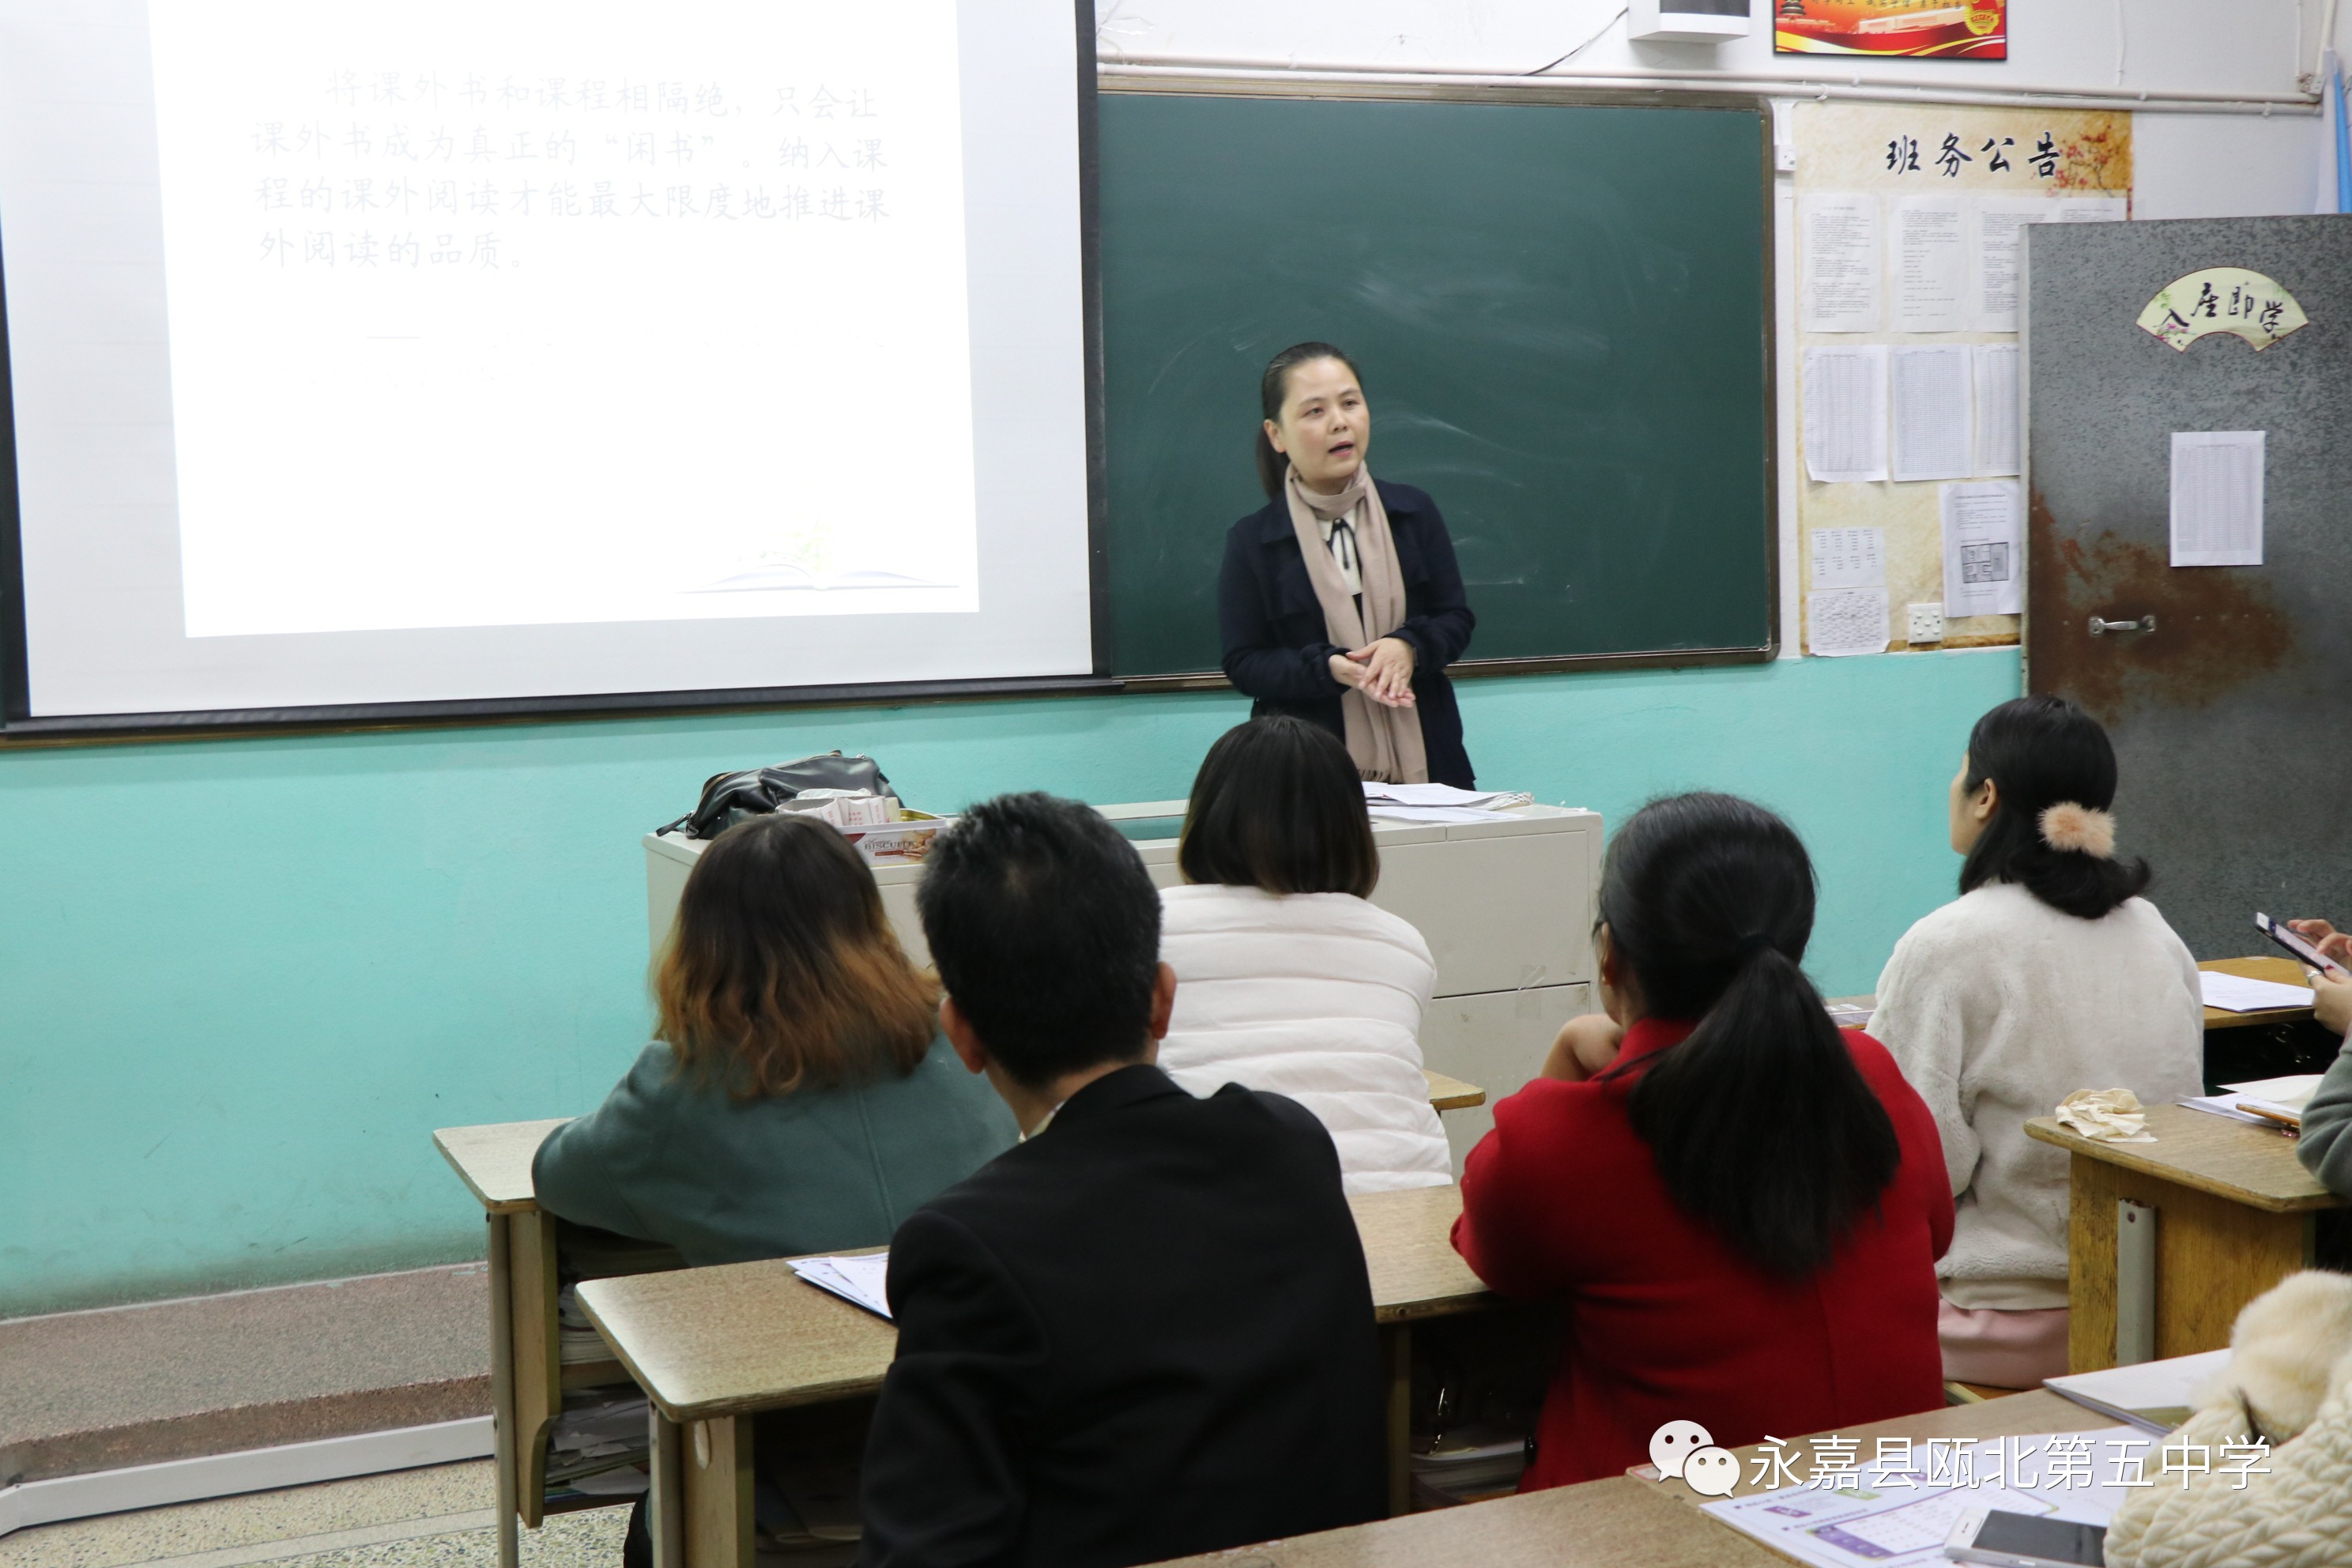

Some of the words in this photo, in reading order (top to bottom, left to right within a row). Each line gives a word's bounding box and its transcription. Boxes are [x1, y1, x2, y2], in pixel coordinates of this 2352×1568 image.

[326, 69, 880, 122] 将课外书和课程相隔绝，只会让
[1886, 130, 2061, 179] 班务公告
[253, 174, 891, 224] 程的课外阅读才能最大限度地推进课
[257, 228, 525, 271] 外阅读的品质。
[2153, 281, 2283, 334] 入座即学
